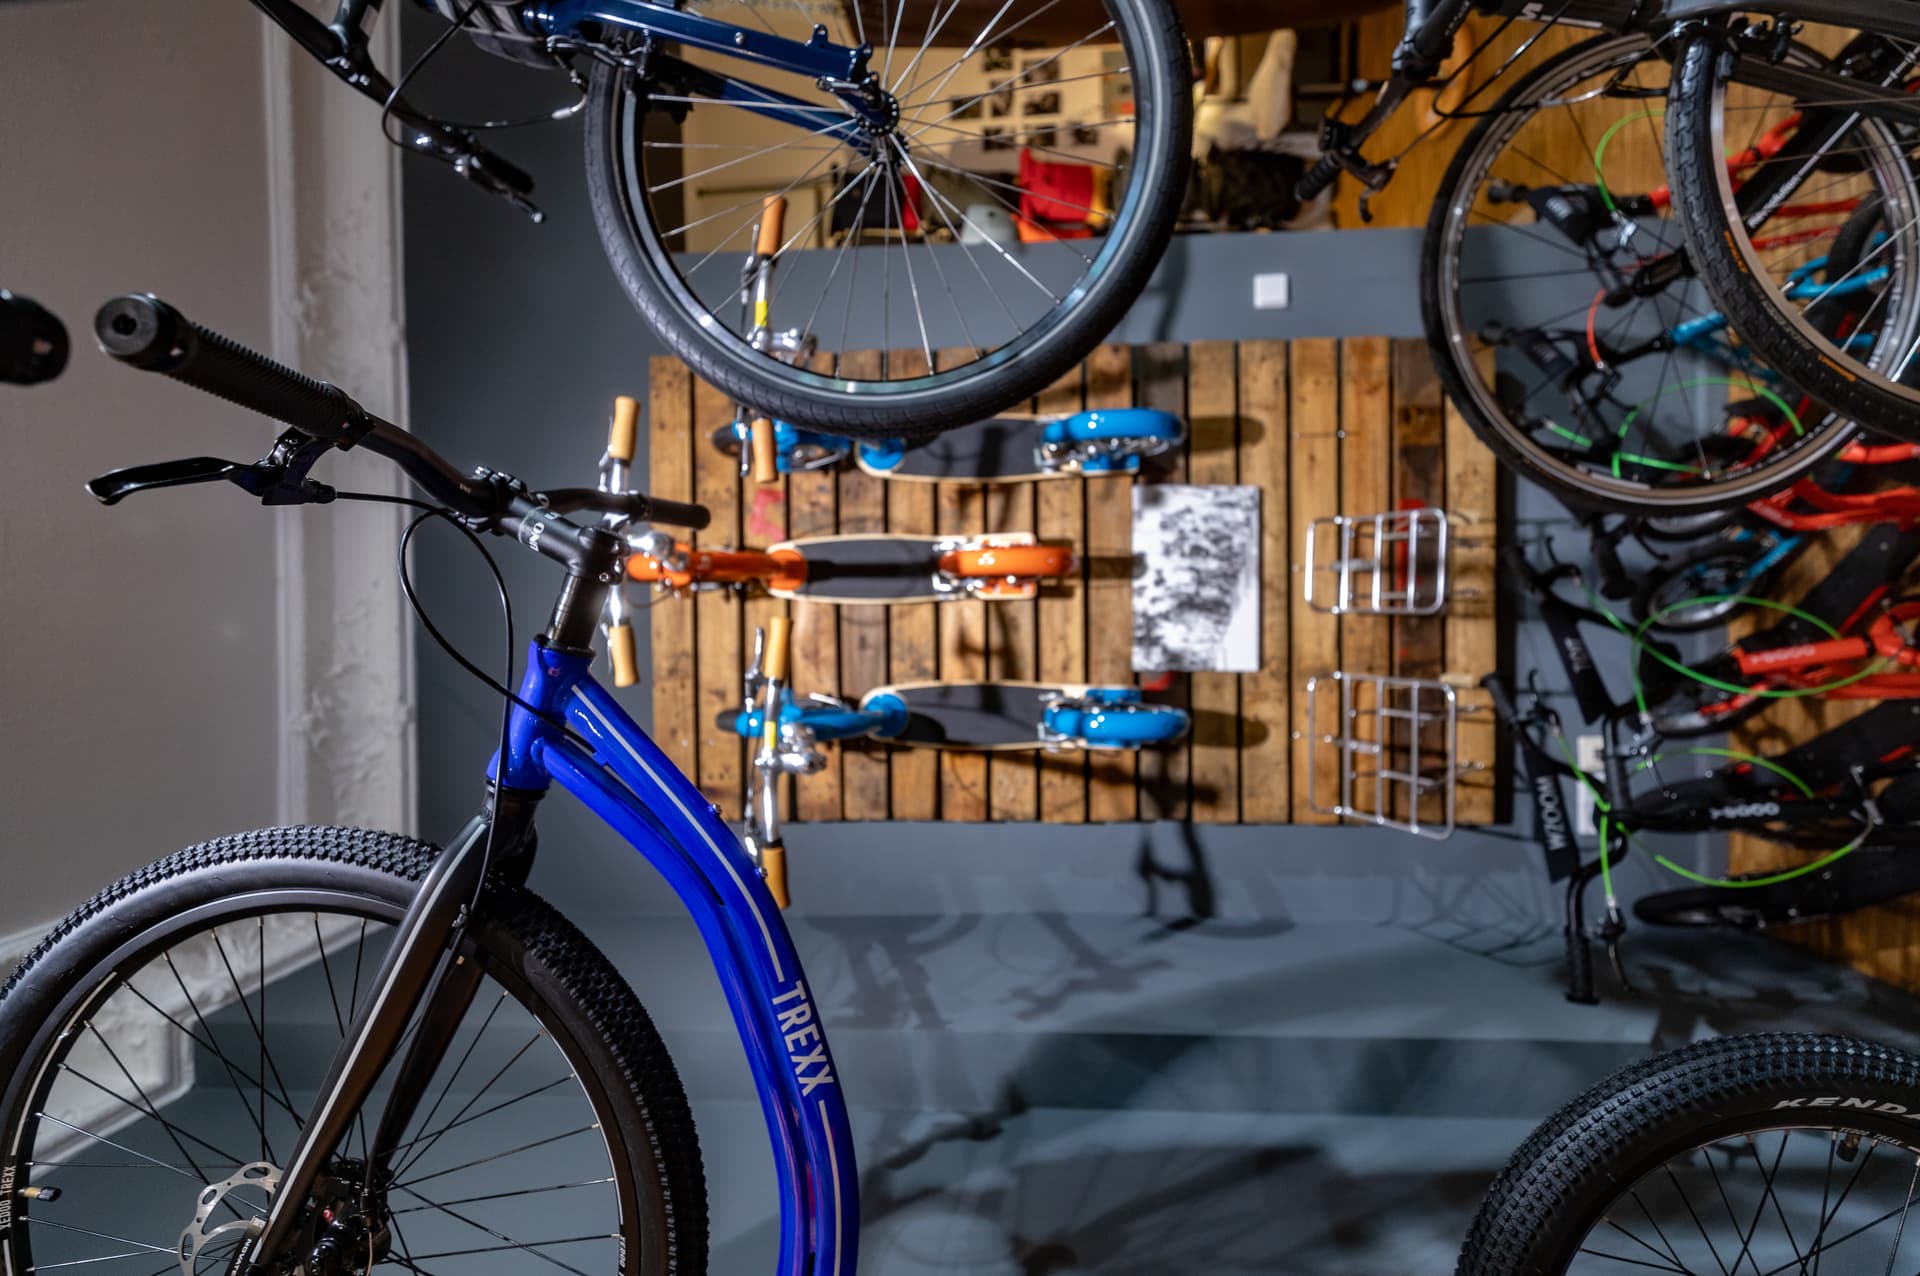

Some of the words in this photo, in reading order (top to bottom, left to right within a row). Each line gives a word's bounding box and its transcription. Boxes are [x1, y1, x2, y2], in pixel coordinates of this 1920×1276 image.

[529, 522, 545, 552] UNO
[1536, 777, 1566, 850] WZOOM
[772, 980, 834, 1097] TREXX
[0, 1165, 16, 1196] TREXX
